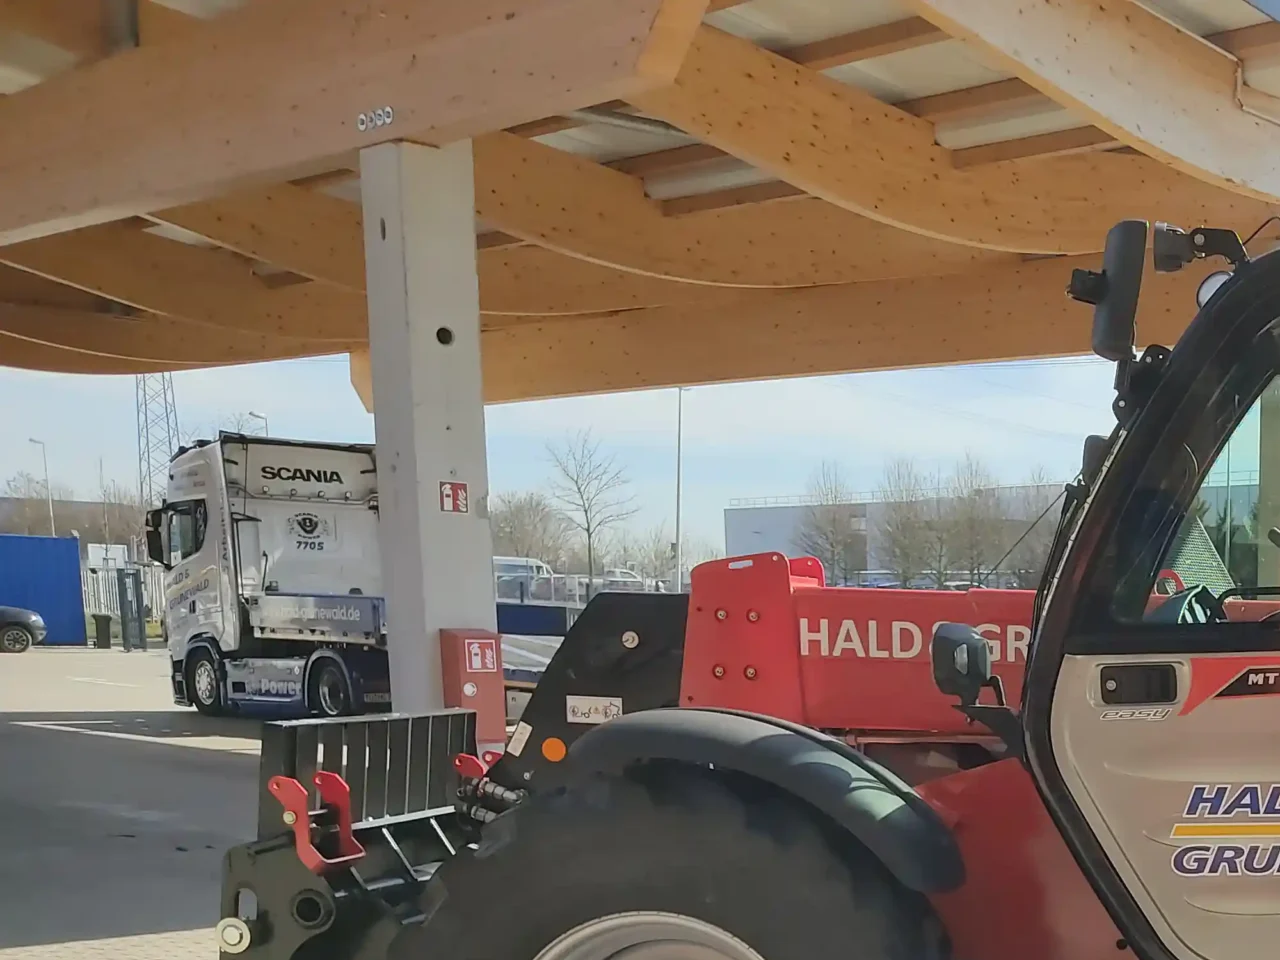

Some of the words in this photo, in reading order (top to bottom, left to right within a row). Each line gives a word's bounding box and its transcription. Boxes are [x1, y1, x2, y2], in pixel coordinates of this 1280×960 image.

[261, 466, 344, 484] SCANIA
[799, 618, 923, 659] HALD
[1247, 672, 1279, 685] MT
[1100, 708, 1173, 721] easy
